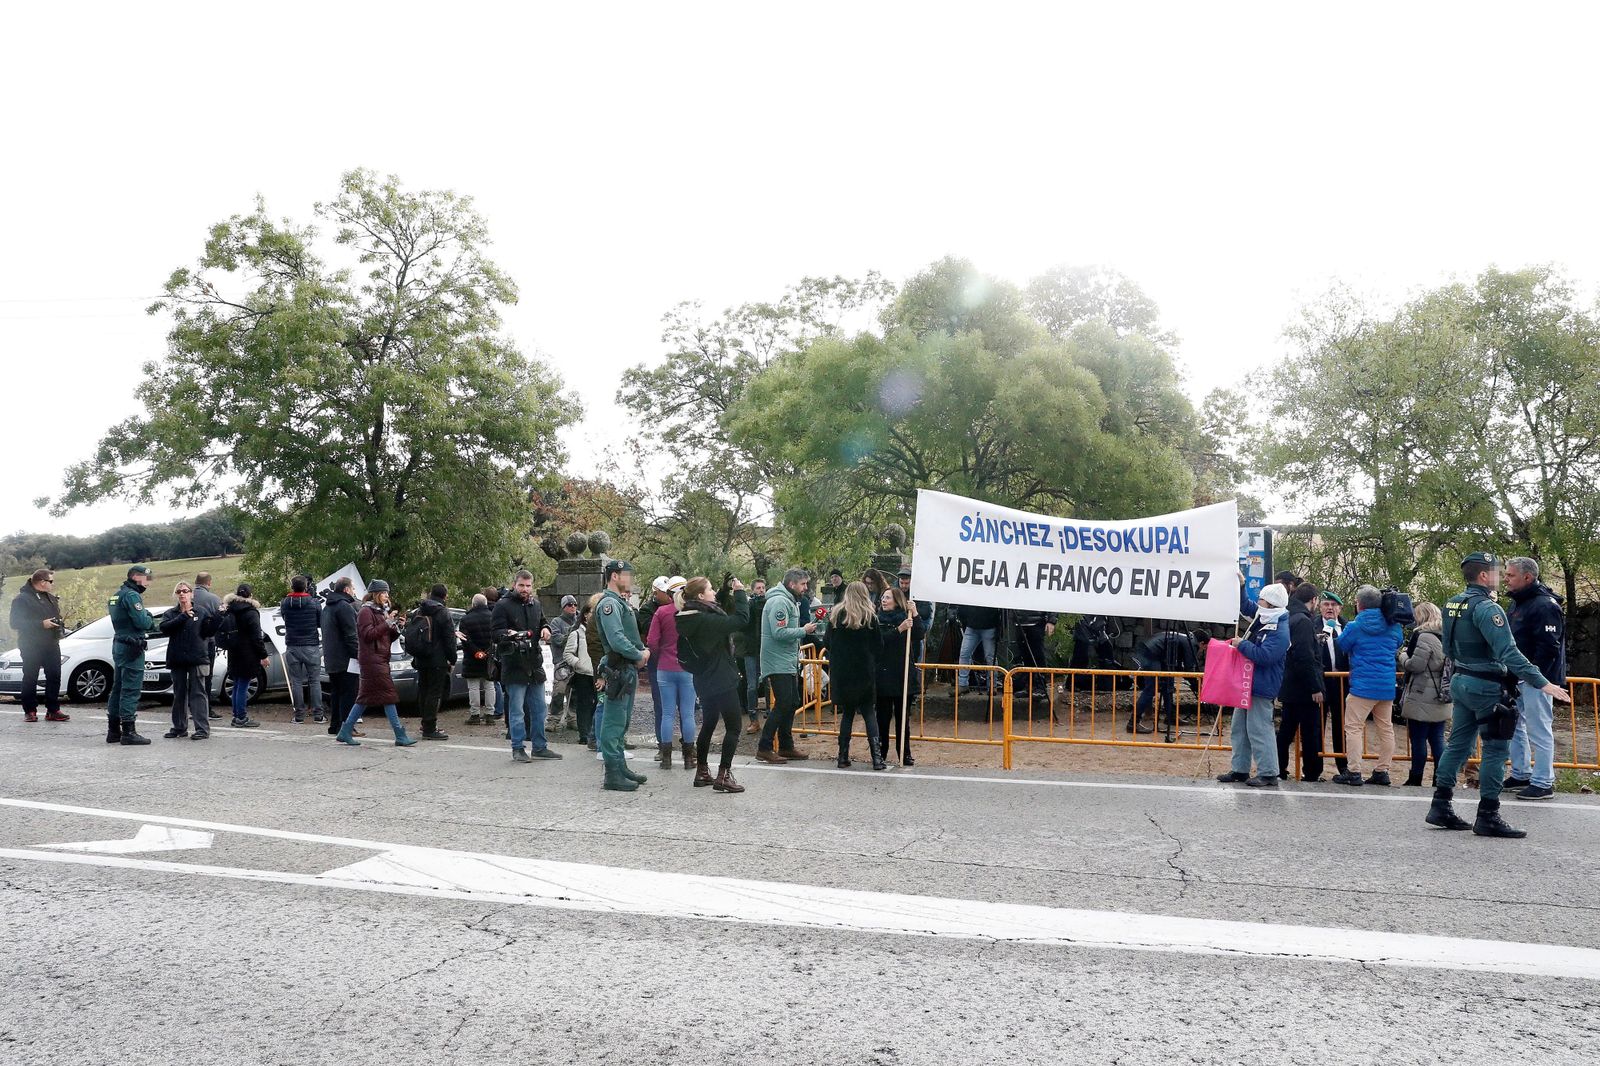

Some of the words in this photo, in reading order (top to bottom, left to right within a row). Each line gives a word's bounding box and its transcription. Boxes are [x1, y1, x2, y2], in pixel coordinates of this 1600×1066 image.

[959, 511, 1053, 548] SÁNCHEZ
[1058, 525, 1190, 555] ¡DESOKUPA!
[939, 556, 951, 583] Y
[957, 557, 1009, 588] DEJA
[1015, 561, 1029, 589] A
[1036, 563, 1123, 595] FRANCO
[1130, 568, 1160, 597] EN
[1167, 569, 1210, 600] PAZ
